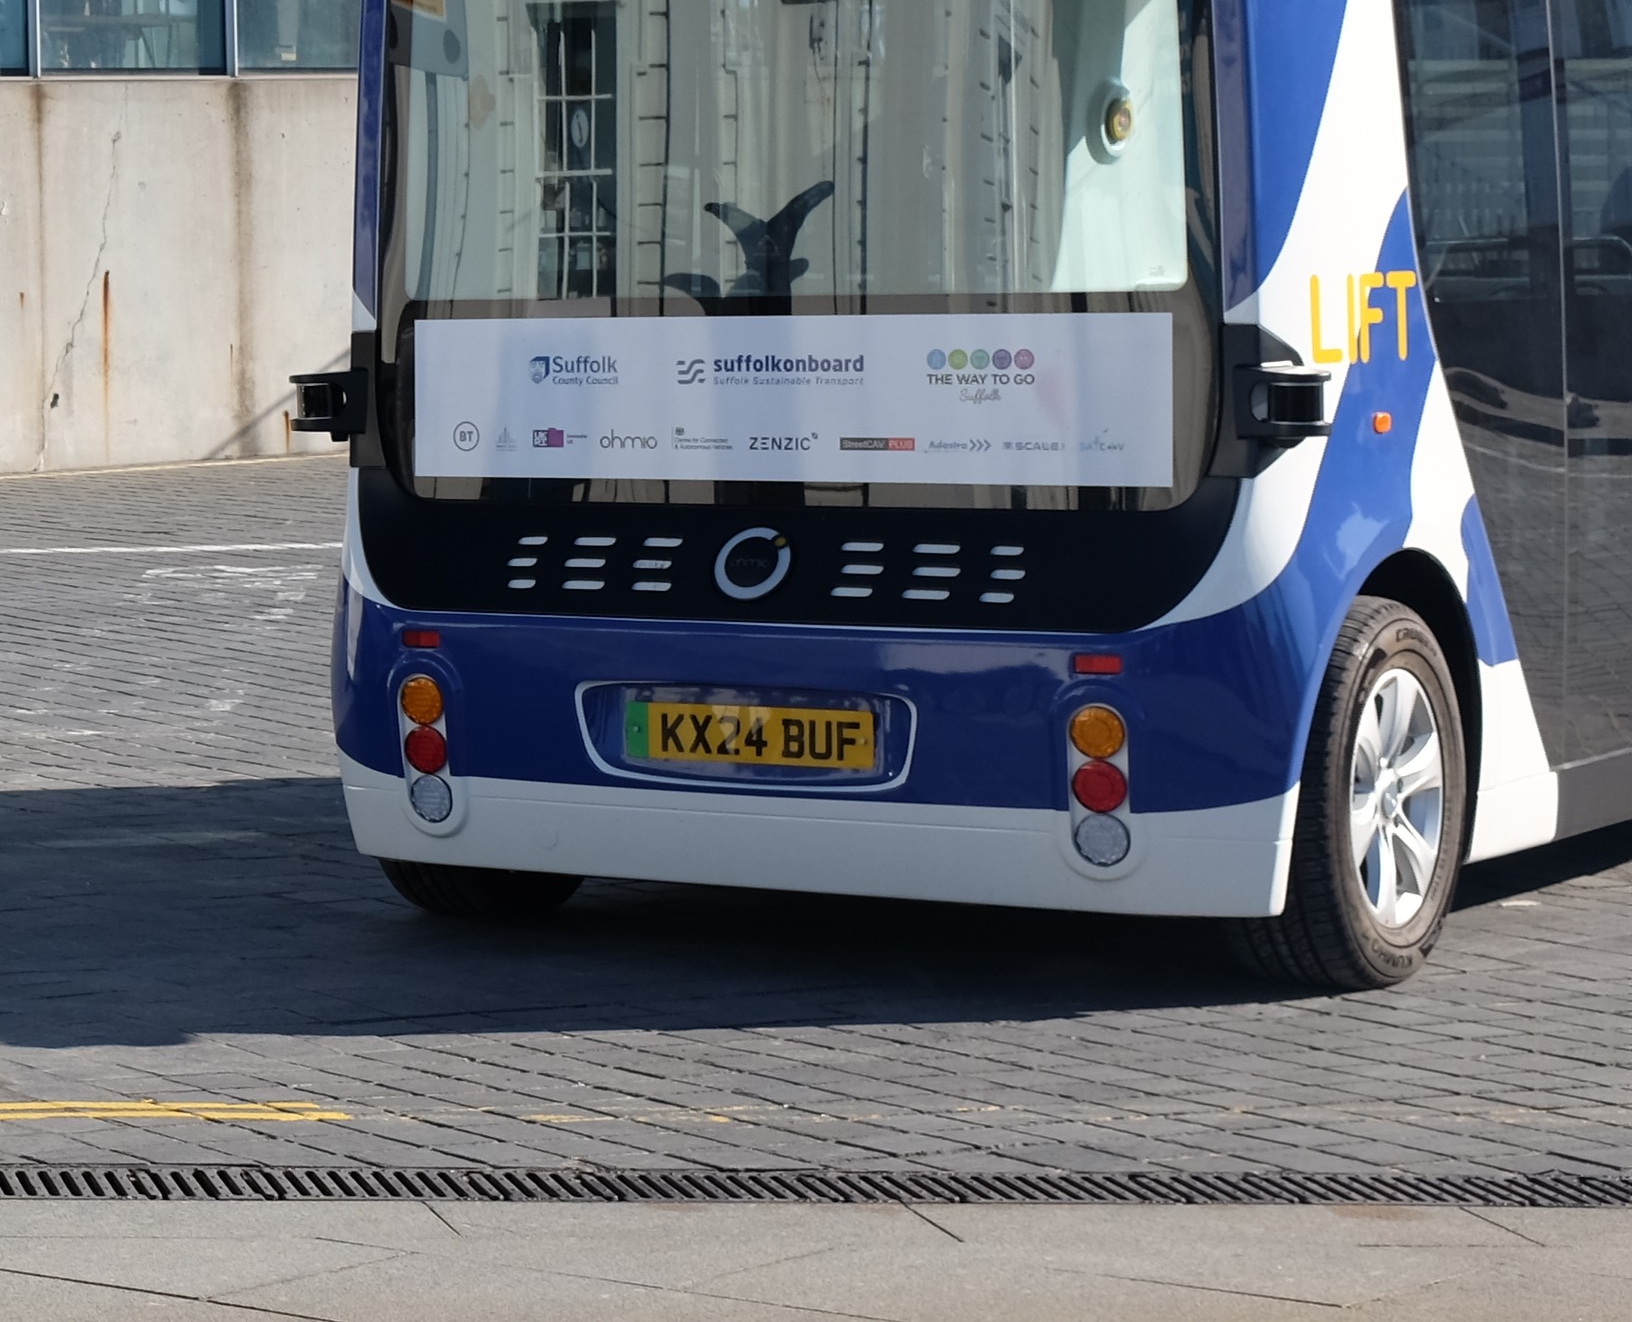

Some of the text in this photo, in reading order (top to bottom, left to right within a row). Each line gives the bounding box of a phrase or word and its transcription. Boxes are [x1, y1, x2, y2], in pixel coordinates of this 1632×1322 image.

[1309, 270, 1417, 365] LIFT
[552, 355, 618, 375] Suffolk
[713, 354, 865, 376] suffolkonboard
[552, 377, 619, 386] County Council
[713, 376, 864, 386] Suffolk Sustainable Transport
[927, 374, 1036, 385] THE WAY TO GO
[459, 431, 474, 442] BT
[599, 429, 658, 449] ohmio
[749, 436, 811, 451] ZENZIC
[842, 439, 914, 449] StreetCAV PLUS
[660, 712, 861, 761] KX24 BUF
